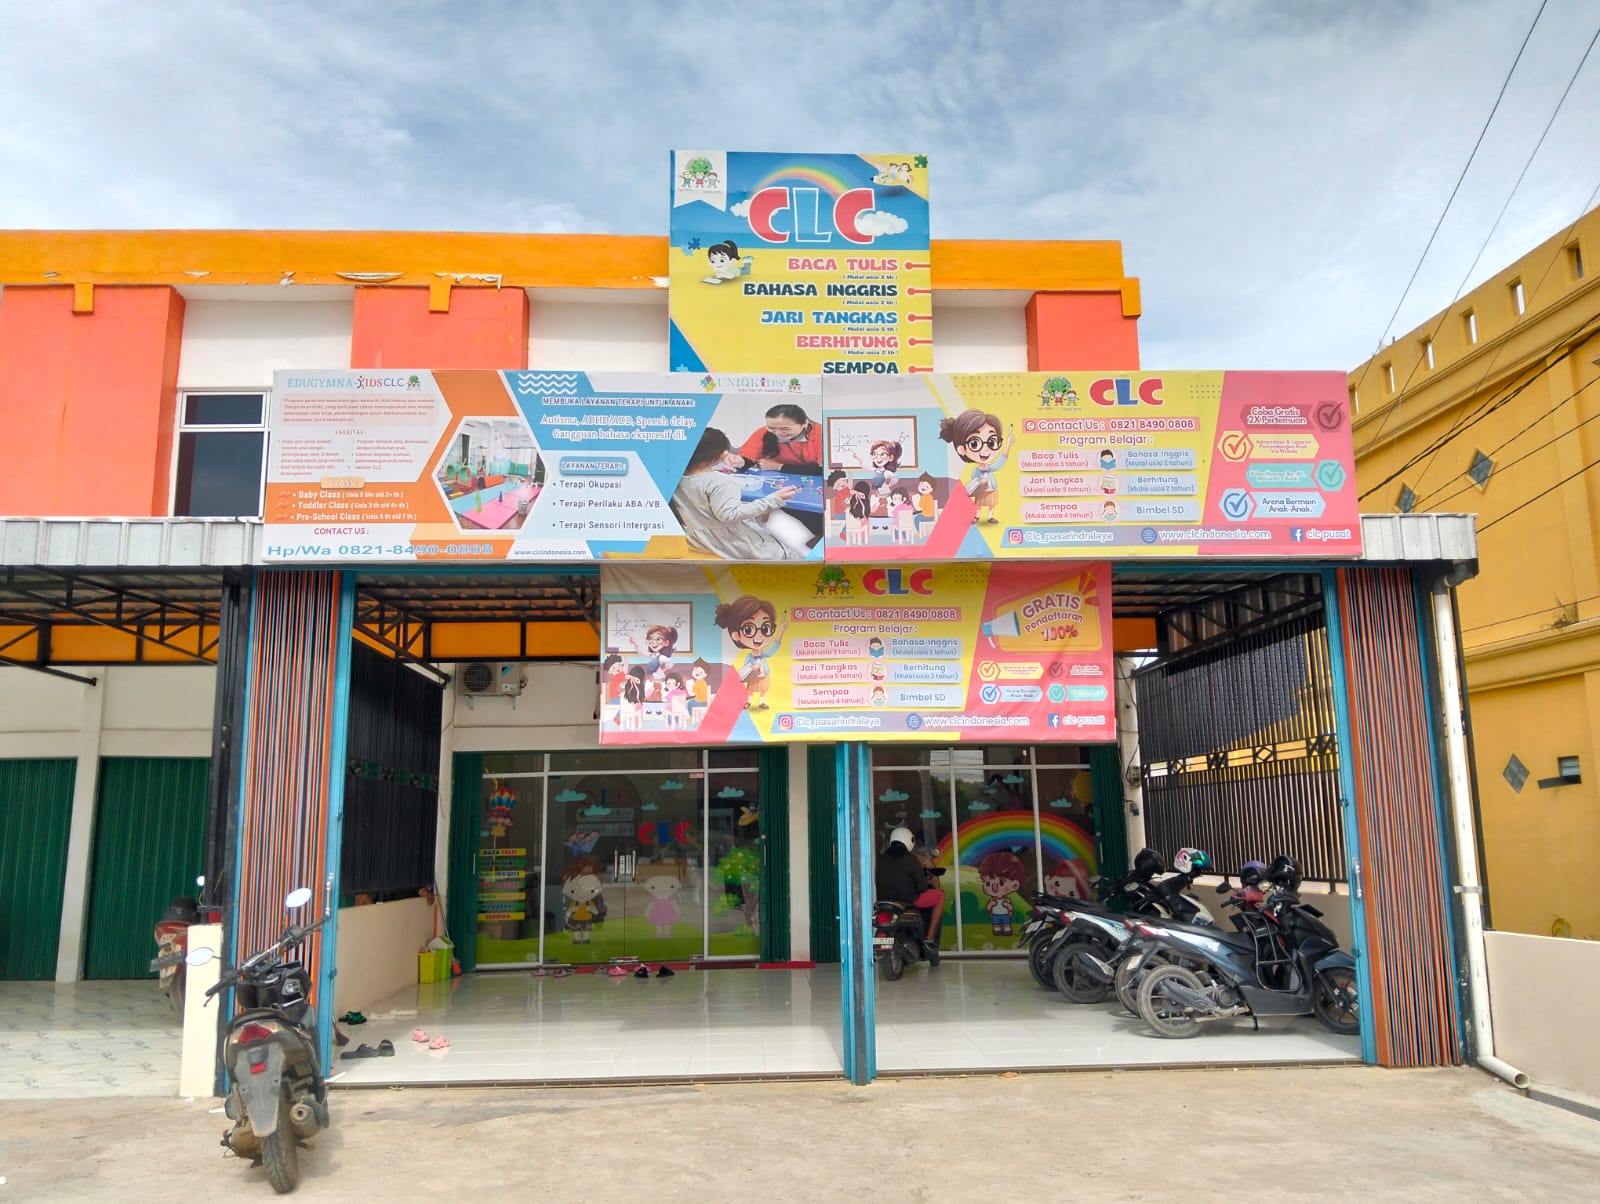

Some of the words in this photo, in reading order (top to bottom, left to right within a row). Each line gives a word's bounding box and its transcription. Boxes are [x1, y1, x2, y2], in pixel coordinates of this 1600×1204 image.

[747, 187, 877, 244] CLC
[788, 258, 838, 272] BACA
[846, 258, 898, 272] TULIS
[744, 283, 818, 297] BAHASA
[827, 283, 899, 297] INGGRIS
[761, 311, 803, 324] JARI
[812, 311, 898, 324] TANGKAS
[796, 335, 899, 348] BERHITUNG
[823, 361, 899, 374] SEMPOA
[288, 378, 353, 388] EDUGYMNA
[1089, 378, 1164, 406] CLC
[1252, 408, 1274, 416] Coba
[1274, 407, 1300, 416] Gratis
[1038, 421, 1084, 430] Contact
[1110, 420, 1136, 430] 0821
[1140, 420, 1165, 429] 8490
[1168, 419, 1194, 428] 0808
[1060, 434, 1106, 447] Program
[1032, 452, 1054, 460] Baca
[1058, 451, 1078, 460] Tulis
[1128, 450, 1159, 458] Bahasa
[1162, 450, 1189, 460] Inggris
[560, 480, 586, 489] Terapi
[588, 480, 622, 489] Okupasi
[1030, 476, 1045, 484] Jari
[1049, 476, 1084, 486] Tangkas
[1138, 476, 1178, 486] Berhitung
[298, 490, 318, 500] Baby
[320, 490, 340, 499] Class
[559, 500, 586, 509] Terapi
[588, 500, 622, 508] Perilaku
[1040, 503, 1078, 512] Sempoa
[1136, 506, 1170, 514] Bimbel
[296, 512, 338, 520] Pre-School
[340, 512, 360, 520] Class
[559, 521, 586, 530] Terapi
[588, 521, 620, 529] Sensori
[624, 521, 664, 531] Intergrasi
[268, 546, 331, 558] Hp/Wa
[338, 544, 493, 556] 0821-8490-0808
[863, 568, 934, 596] CLC
[1022, 592, 1082, 620] GRATIS
[808, 609, 851, 619] Contact
[876, 609, 900, 619] 0821
[903, 609, 928, 619] 8490
[931, 609, 956, 619] 0808
[833, 624, 876, 635] Program
[1041, 624, 1078, 642] 100%
[804, 640, 826, 648] Baca
[830, 640, 849, 648] Tulis
[892, 638, 925, 646] Bahasa
[928, 638, 958, 648] Inggris
[800, 664, 817, 672] Jari
[820, 664, 858, 673] Tangkas
[904, 663, 946, 673] Berhitung
[813, 688, 849, 698] Sempoa
[900, 694, 932, 702] Bimbel
[934, 694, 946, 702] SD
[638, 820, 692, 846] CLC
